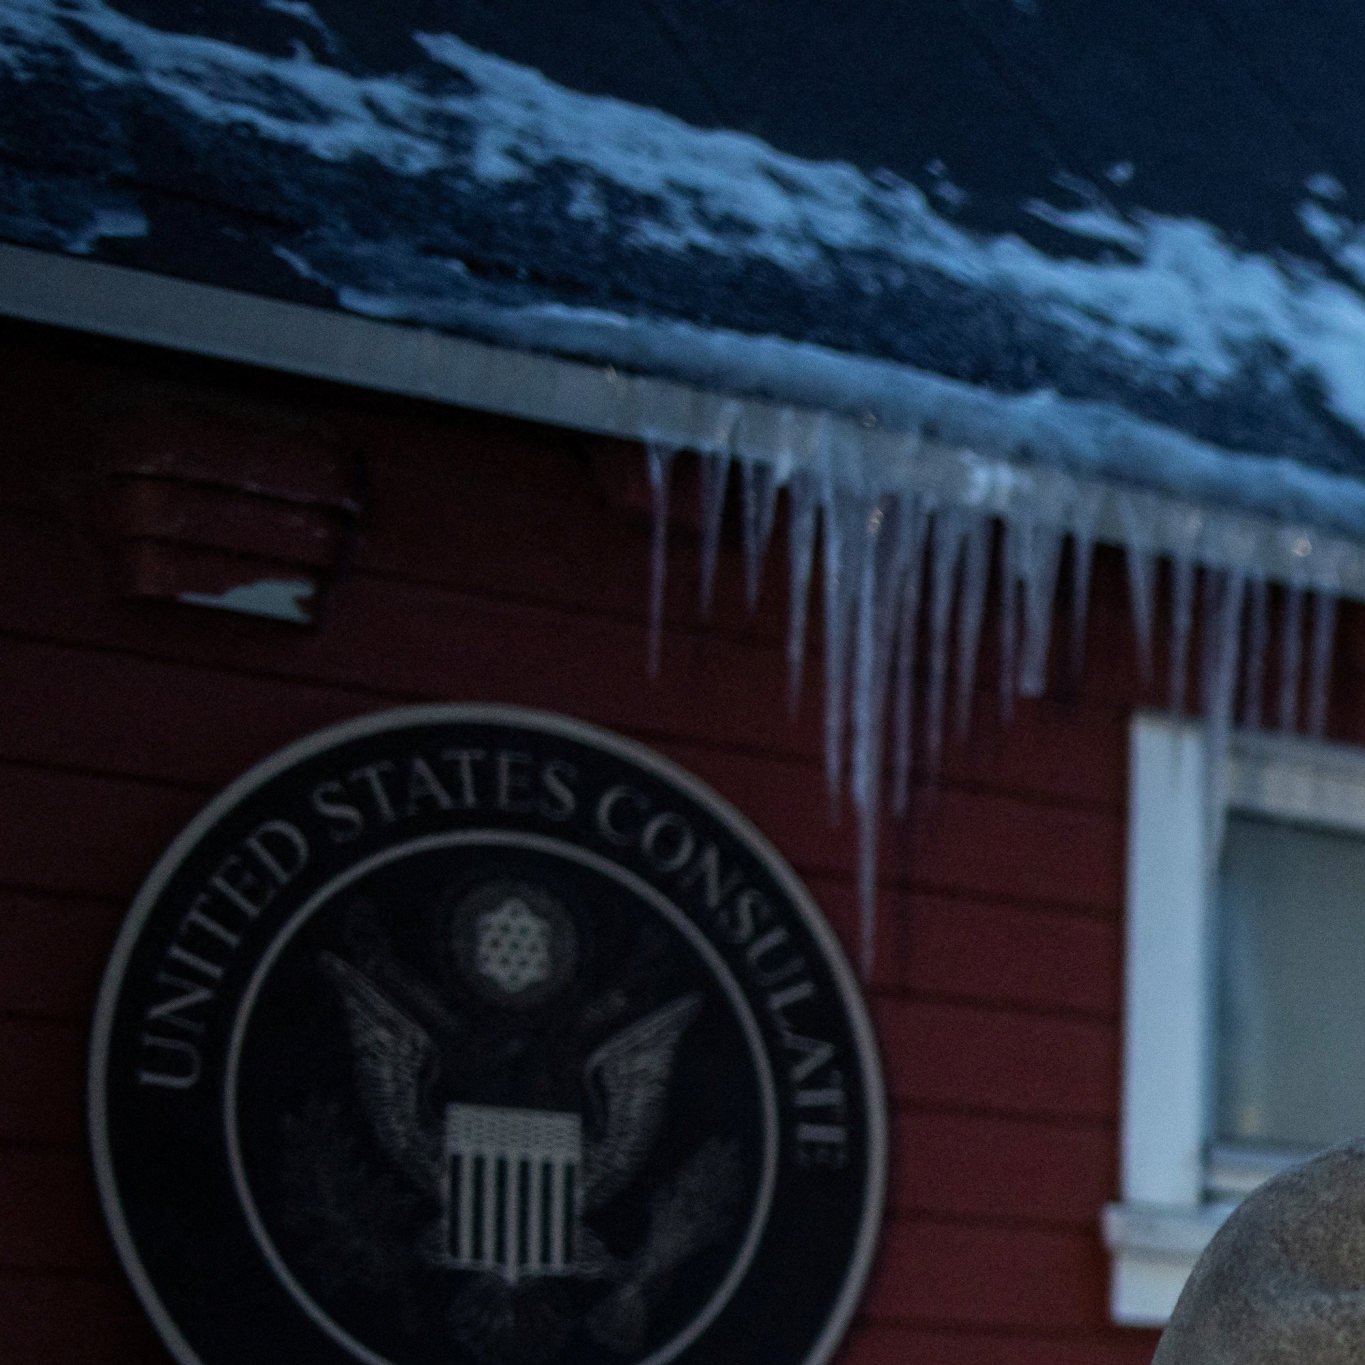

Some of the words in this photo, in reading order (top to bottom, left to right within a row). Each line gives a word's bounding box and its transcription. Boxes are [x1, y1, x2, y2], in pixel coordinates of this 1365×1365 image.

[138, 819, 310, 1090] UNITED
[311, 747, 578, 843] STATES
[597, 784, 848, 1169] CONSULATE
